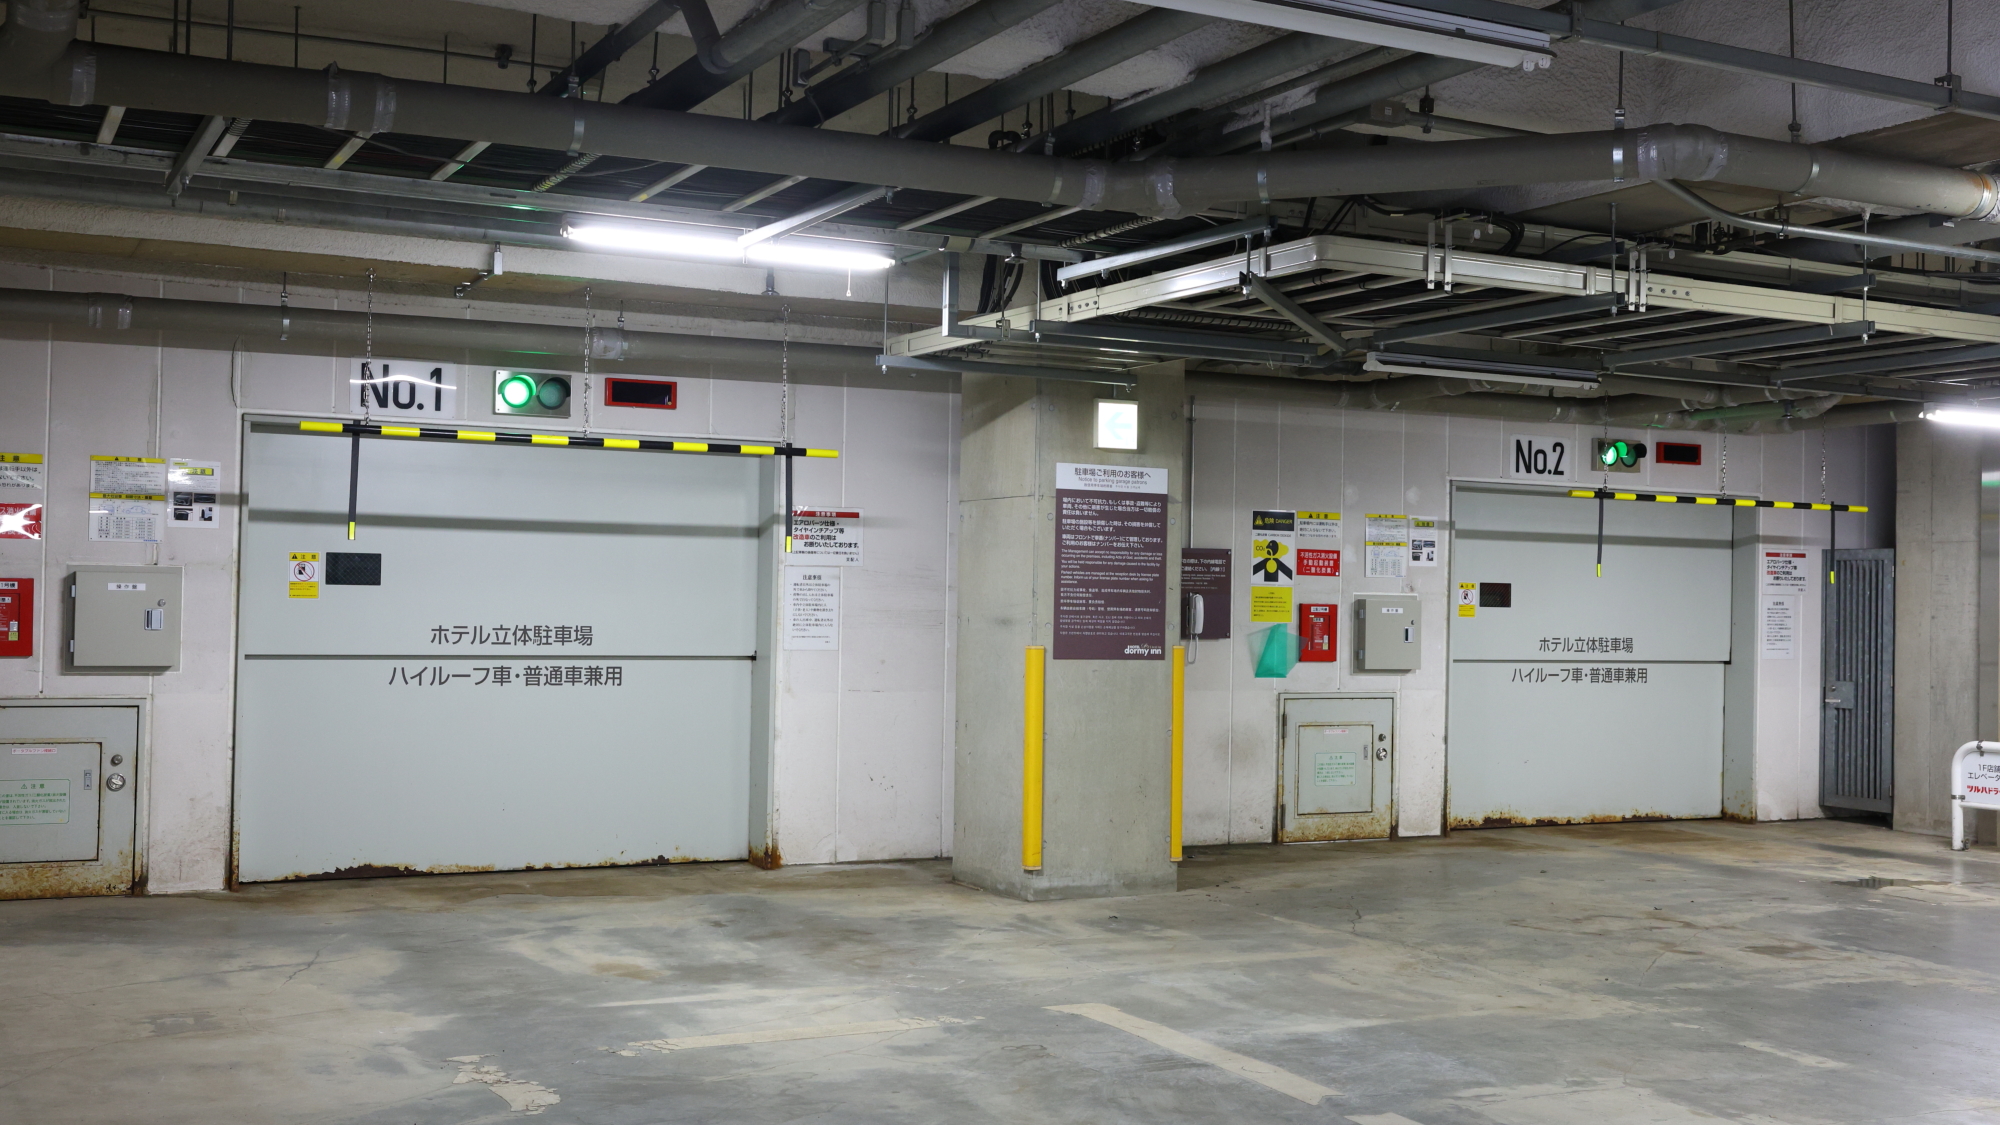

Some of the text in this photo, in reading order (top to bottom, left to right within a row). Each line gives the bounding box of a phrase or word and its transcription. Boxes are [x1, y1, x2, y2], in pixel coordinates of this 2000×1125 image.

[361, 362, 443, 412] No.1
[1515, 439, 1564, 475] No.2
[1074, 467, 1152, 479] 駐車場ご利用のお客様へ
[430, 624, 594, 646] ホテル立体駐車場
[1539, 636, 1634, 653] ホテル立体駐車場
[1124, 645, 1149, 656] dormy
[388, 665, 623, 687] ハイルーフ車・普通車兼用
[1512, 667, 1648, 684] ハイルーフ車・普通車兼用
